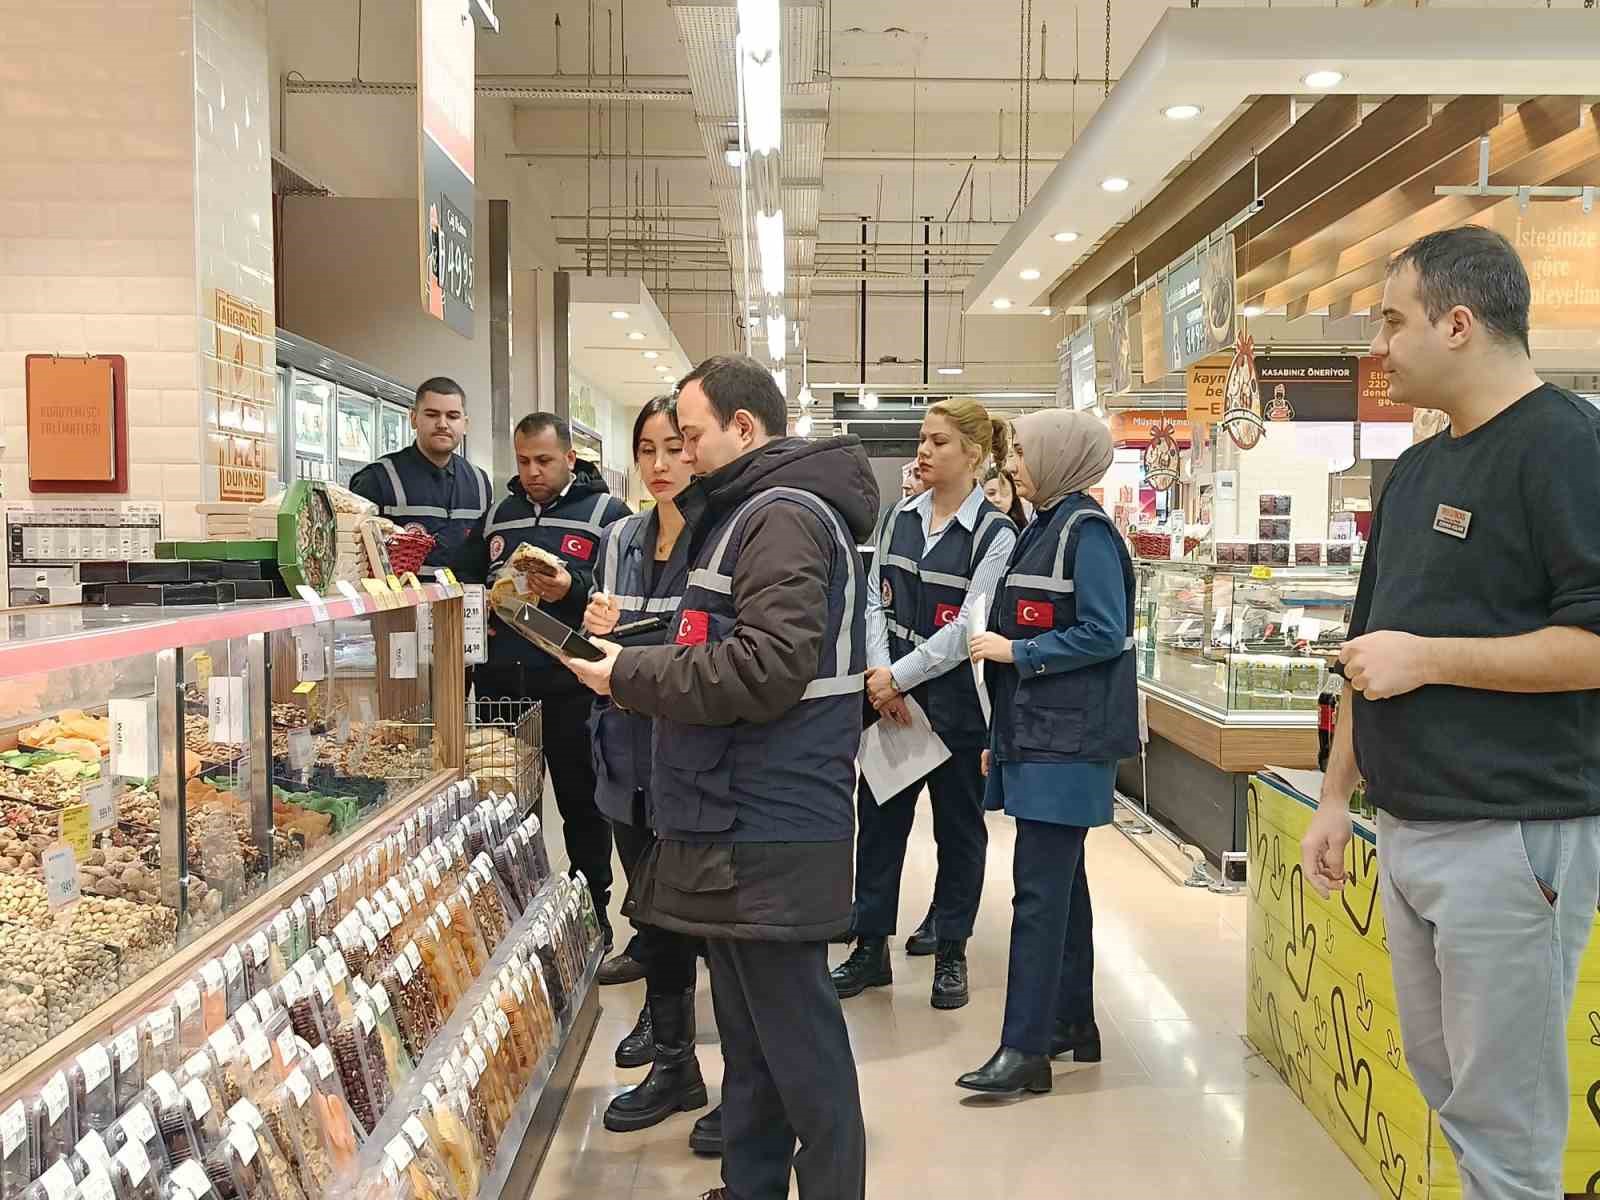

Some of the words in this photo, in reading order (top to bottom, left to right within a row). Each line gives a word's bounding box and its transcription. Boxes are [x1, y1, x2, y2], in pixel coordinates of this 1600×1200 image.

[1261, 367, 1303, 377] KASABINIZ
[1306, 365, 1350, 377] ÖNERİYOR
[1192, 371, 1226, 385] kayn
